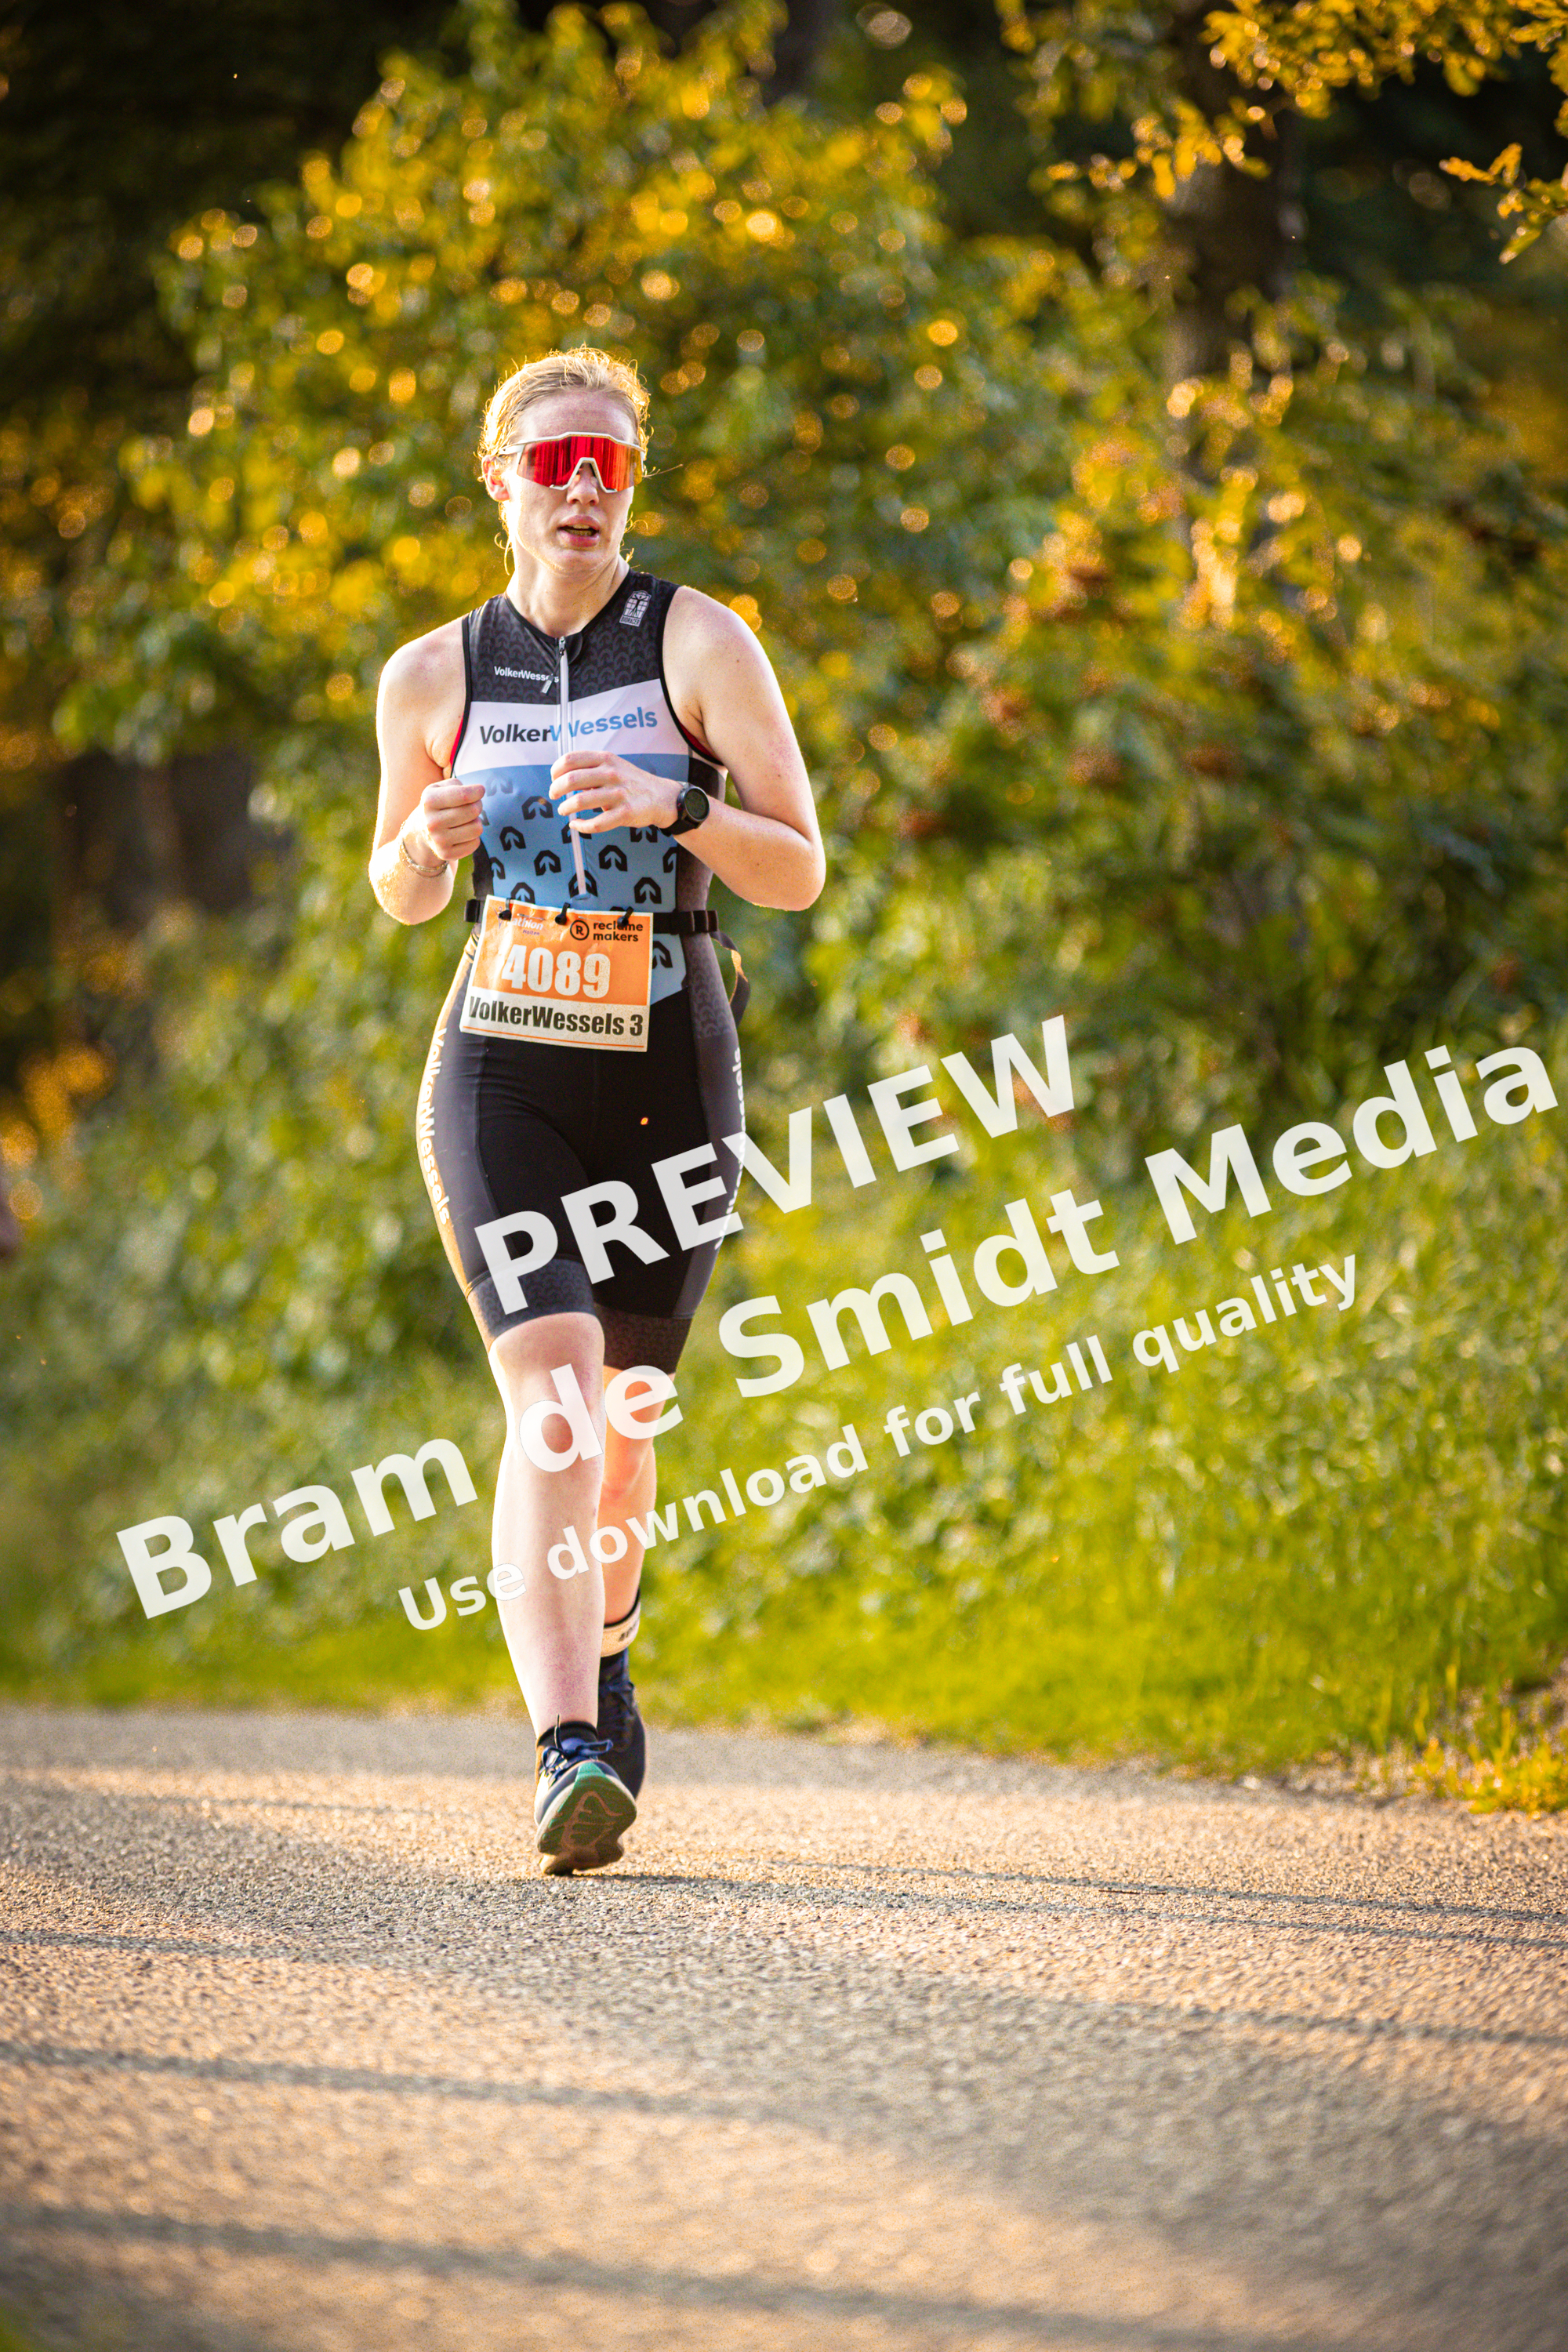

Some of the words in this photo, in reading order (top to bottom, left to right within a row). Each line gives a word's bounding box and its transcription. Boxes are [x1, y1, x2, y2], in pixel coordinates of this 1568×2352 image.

[494, 666, 559, 683] VolkerWesss
[480, 707, 658, 745] VolkerWessels
[506, 916, 543, 931] athlon
[593, 931, 638, 942] makers
[501, 944, 610, 999] 4089
[469, 996, 624, 1035] VolkerWessels
[630, 1014, 643, 1036] 3
